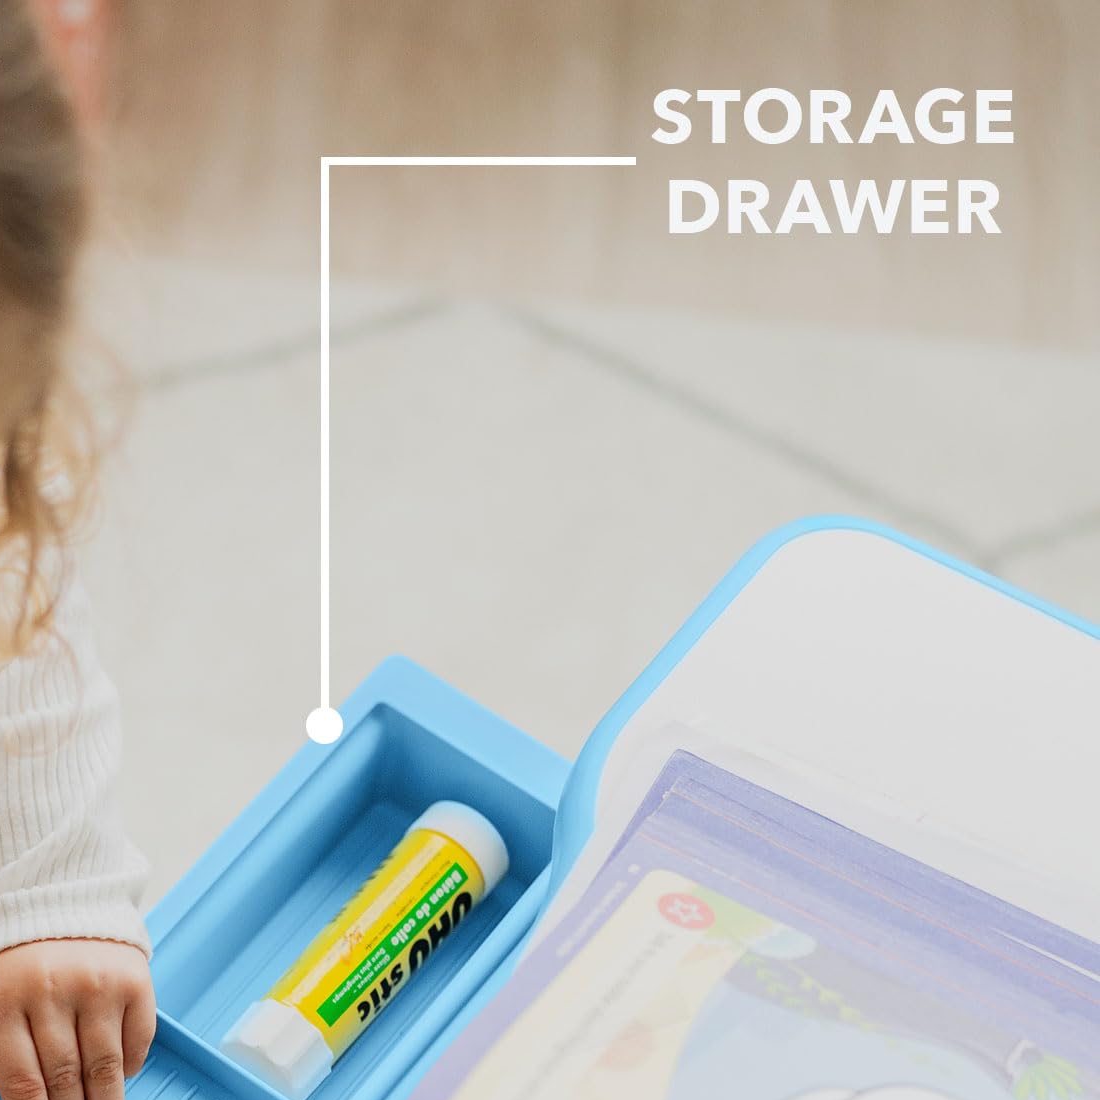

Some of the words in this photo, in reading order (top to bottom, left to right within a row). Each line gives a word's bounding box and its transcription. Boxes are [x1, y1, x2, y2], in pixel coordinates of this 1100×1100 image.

[415, 902, 431, 920] de
[390, 918, 416, 946] colle
[408, 891, 473, 975] UHU
[359, 960, 372, 975] plus
[332, 973, 362, 1003] longtemps
[357, 963, 404, 1022] stic
